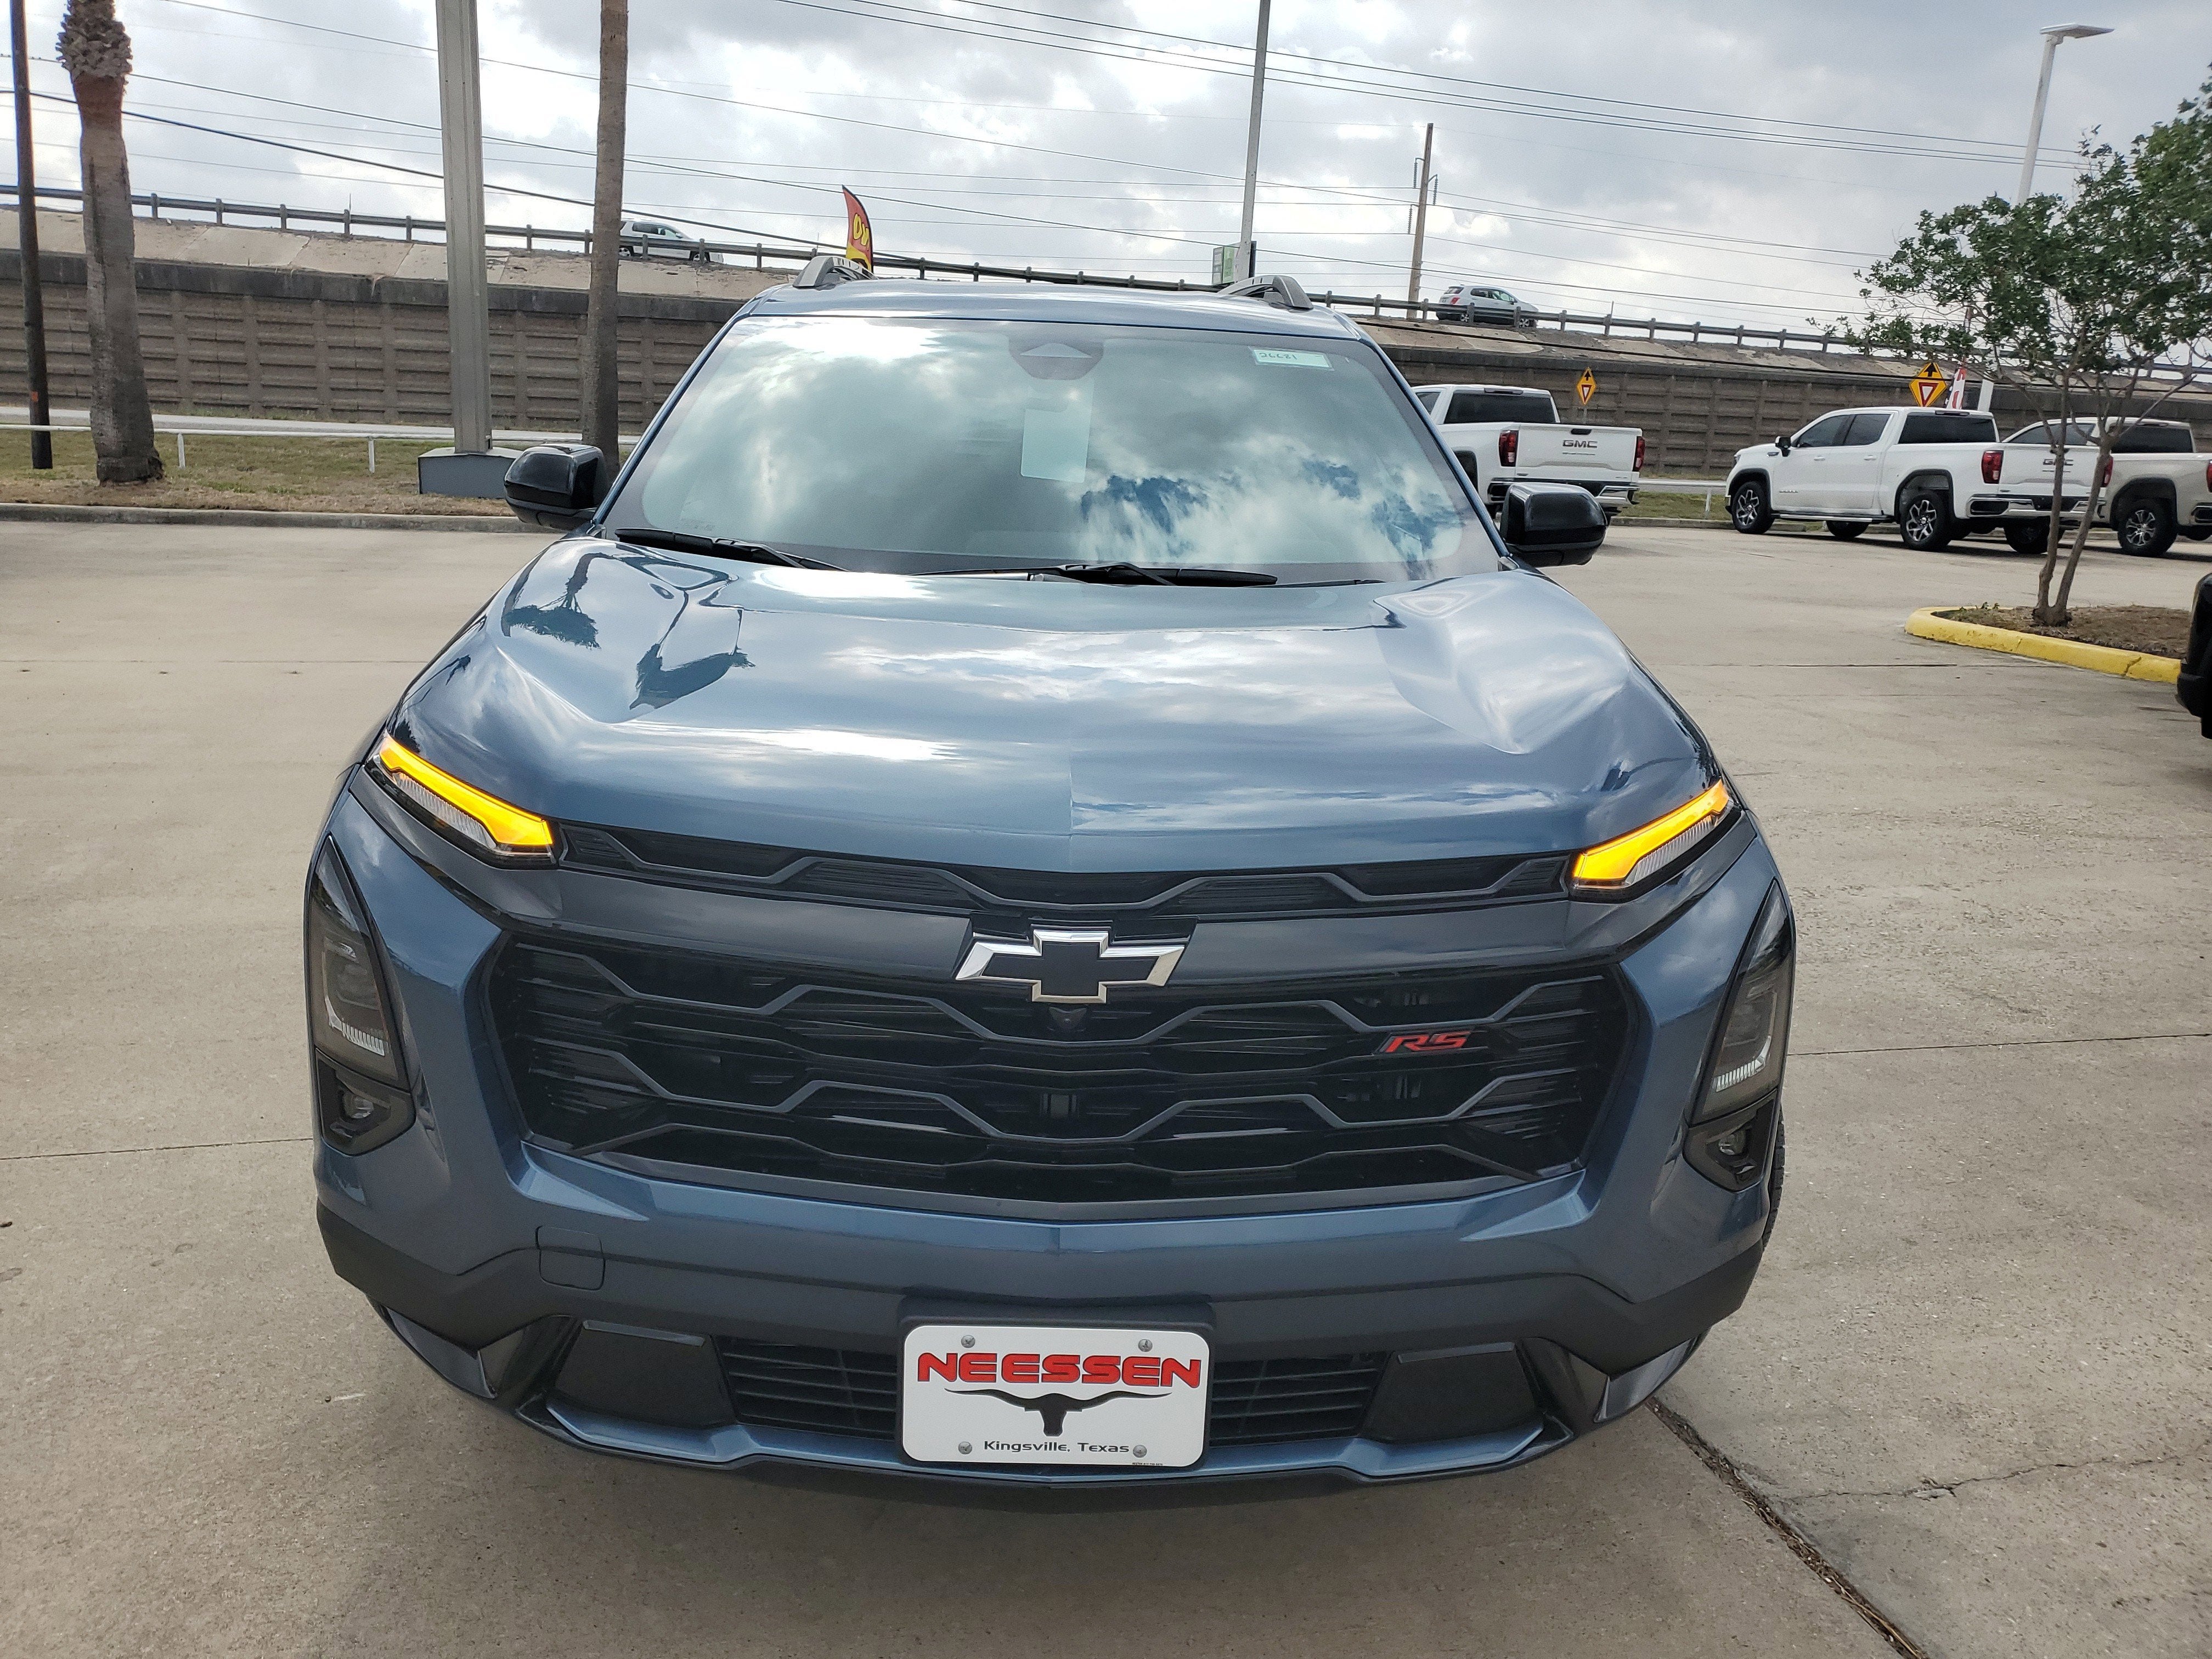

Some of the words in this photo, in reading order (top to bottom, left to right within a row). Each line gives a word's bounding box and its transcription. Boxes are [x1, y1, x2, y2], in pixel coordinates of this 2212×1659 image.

[1562, 439, 1598, 448] GMC
[1379, 1031, 1471, 1053] RS
[917, 1352, 1201, 1389] NEESSEN
[984, 1441, 1070, 1453] Kingsville,
[1077, 1442, 1130, 1453] Texas
